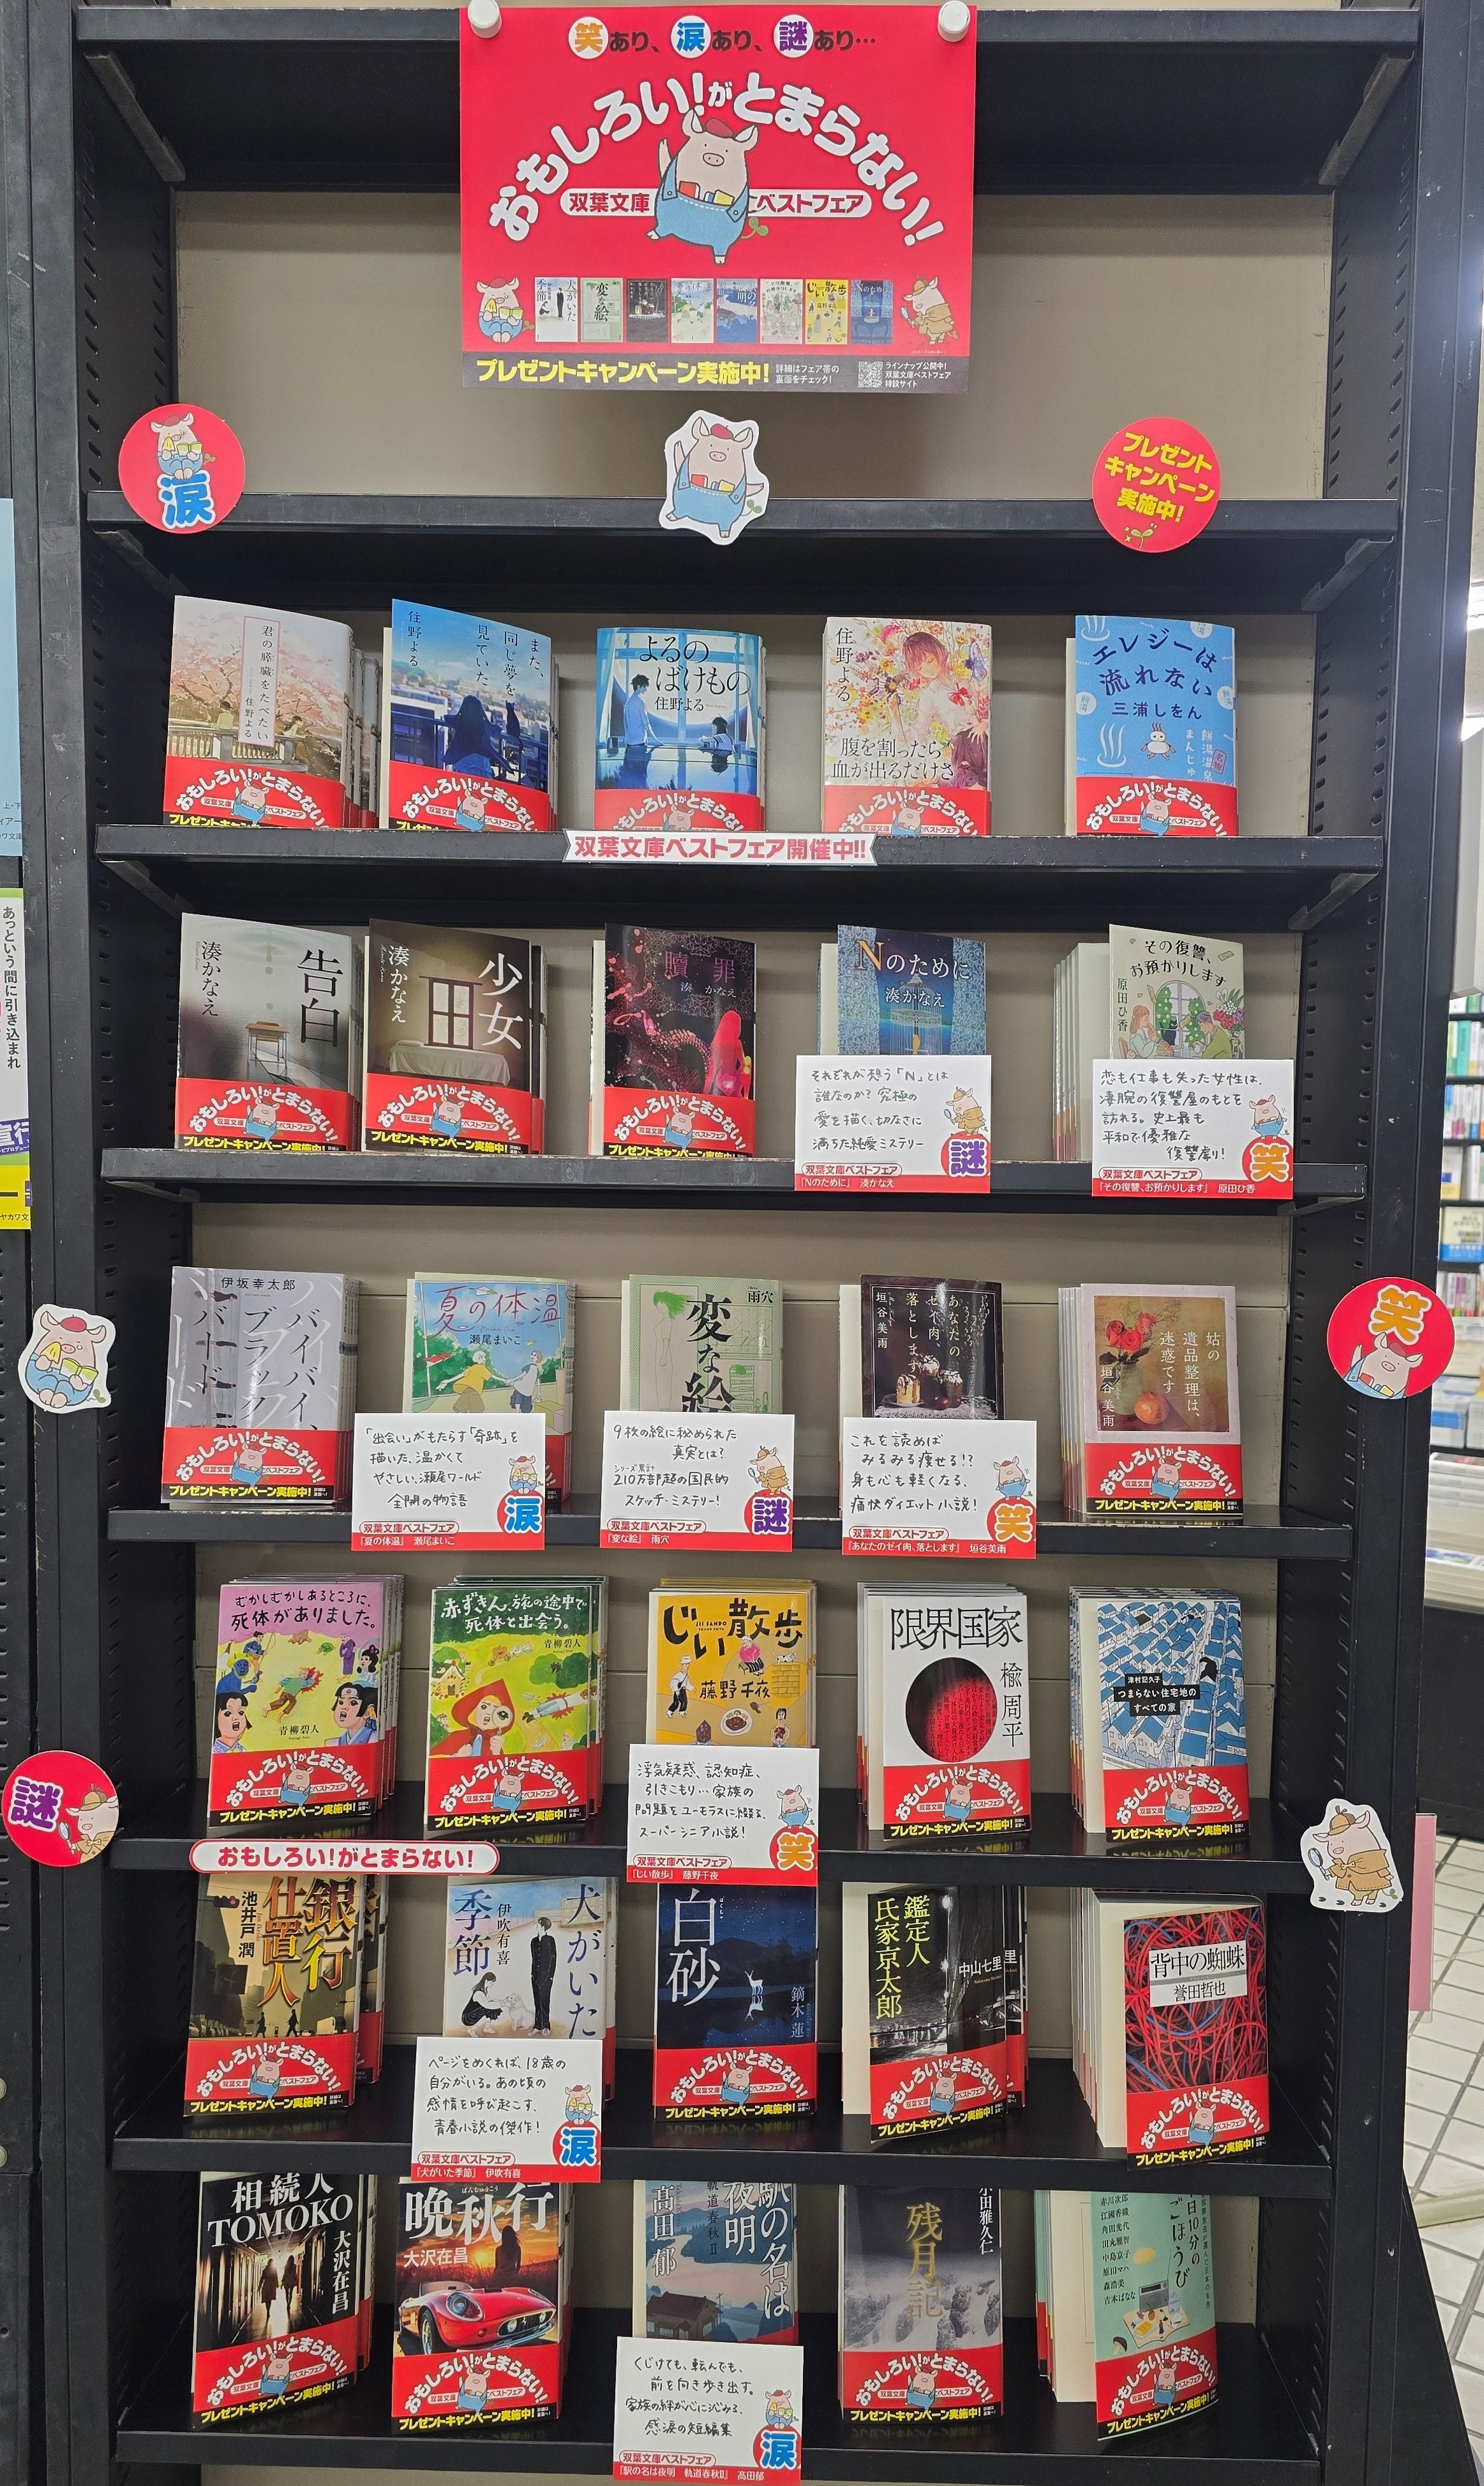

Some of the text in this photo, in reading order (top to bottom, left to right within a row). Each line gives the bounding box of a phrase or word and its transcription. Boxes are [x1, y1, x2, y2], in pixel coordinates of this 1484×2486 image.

[489, 71, 944, 246] おもしろい!がとまらない!
[569, 192, 865, 214] 双葉文庫 ベストフェア
[594, 283, 609, 321] 変な絵
[478, 359, 769, 386] プレゼントキャンペーン実施中!
[776, 365, 839, 373] 詳細はフェア帯の
[1123, 432, 1212, 473] プレゼント
[1104, 456, 1215, 502] キャンペーン
[1117, 487, 1184, 522] 実施中!
[408, 611, 422, 667] 住野よる
[476, 625, 490, 686] 見ていた
[639, 636, 709, 664] よるの
[1093, 628, 1217, 673] エレジーは
[504, 631, 518, 696] 同じ夢を
[529, 639, 544, 677] また、
[835, 627, 854, 702] 住野よる
[257, 625, 275, 740] 君の膵臓をたべたい
[655, 666, 752, 695] ばけもの
[1099, 664, 1212, 696] 流れない
[244, 697, 254, 738] 住野よる
[655, 697, 704, 711] 住野よる
[1112, 701, 1202, 720] 三浦しをん
[841, 738, 941, 758] 腹を割ったら
[831, 761, 954, 781] 血が出るだけさ
[574, 836, 866, 860] 双葉文庫ベストフェア開催中!!
[857, 940, 971, 981] Nのために
[1144, 939, 1212, 964] その復讐、
[202, 940, 222, 1017] 湊かなえ
[388, 945, 410, 1023] 湊かなえ
[1130, 959, 1226, 987] お預かりします
[297, 949, 343, 1047] 告白
[478, 953, 524, 1049] 少女
[885, 987, 946, 1009] 湊かなえ
[1117, 977, 1128, 1033] 原田ひ香
[189, 1085, 338, 1142] おもしろい!がとまらない!
[1102, 1130, 1190, 1144] 平和で優雅な
[805, 1165, 898, 1176] 双葉文庫ベストフェア
[1252, 1144, 1287, 1182] 笑
[859, 1178, 894, 1189] 湊かなえ
[1099, 1182, 1256, 1194] 『その復讐、お預かりします』 原田ひ香
[221, 1276, 296, 1291] 伊坂幸太郎
[747, 1289, 774, 1304] 雨穴
[422, 1285, 562, 1341] 夏の体温
[876, 1292, 889, 1350] 垣谷美雨
[948, 1294, 960, 1358] あなたの
[1370, 1287, 1430, 1343] 笑
[469, 1334, 522, 1345] 瀬尾まいこ
[906, 1292, 919, 1372] 落とします
[1205, 1332, 1221, 1362] 姑の
[681, 1293, 737, 1413] 変な絵
[1160, 1331, 1176, 1395] 迷惑です
[1182, 1331, 1200, 1420] 遺品整理は、
[1100, 1367, 1115, 1427] 垣谷美雨
[176, 1431, 326, 1483] おもしろい!がとまらない!
[851, 1433, 944, 1448] これを読めば
[169, 1485, 312, 1498] プレゼントキャンペーン実施中!
[387, 1492, 468, 1509] 全開の物語
[611, 1521, 702, 1532] 双葉文庫ベストフェア
[753, 1498, 788, 1533] 謎
[413, 1535, 455, 1546] 瀬尾まいこ
[651, 1533, 670, 1545] 雨穴
[852, 1528, 945, 1540] 双葉文庫ベストフェア
[969, 1543, 1006, 1554] 垣谷美雨
[235, 1589, 371, 1609] むかしむかしあるところに、
[441, 1591, 588, 1619] 赤ずきん、旅の途中で
[230, 1607, 377, 1631] 死体がありました。
[465, 1614, 569, 1634] 死体と出会う。
[663, 1597, 803, 1660] じい散歩
[891, 1605, 1024, 1651] 限界国家
[544, 1639, 581, 1649] 青柳碧人
[699, 1679, 771, 1700] 藤野千夜
[1118, 1687, 1196, 1698] つまらない住宅地の
[1128, 1676, 1161, 1684] 津村記久子
[1000, 1662, 1024, 1748] 楡周平
[1134, 1703, 1176, 1713] すべての家
[278, 1725, 320, 1736] 青柳碧人
[10, 1778, 62, 1831] 謎
[219, 1803, 356, 1823] プレゼントキャンペーン実施中!
[218, 1847, 474, 1868] おもしろい!がとまらない!
[682, 1869, 719, 1881] 藤野千夜
[239, 1891, 258, 1959] 池井戸潤
[256, 1876, 306, 2008] 仕置人
[301, 1876, 358, 1991] 銀行
[452, 1889, 493, 1976] 季節
[496, 1903, 511, 1966] 伊吹有喜
[903, 1895, 931, 1967] 鑑定人
[567, 1883, 602, 2040] 犬がいた
[666, 1887, 721, 2007] 白砂
[874, 1897, 903, 2020] 氏家京太郎
[1151, 1944, 1245, 1979] 背中の蜘蛛
[959, 1955, 1002, 1978] 中山七里
[1174, 1983, 1226, 2002] 誉田哲也
[670, 2050, 808, 2104] おもしろい!がとまらない!
[560, 2128, 596, 2165] 涙
[485, 2167, 522, 2179] 伊吹有喜
[231, 2173, 334, 2213] 相続人
[1100, 2194, 1129, 2207] 赤川次郎
[207, 2193, 354, 2248] TOMOKO
[405, 2182, 554, 2245] 晩秋行
[723, 2182, 757, 2256] 夜明
[1102, 2221, 1130, 2235] 角田光代
[403, 2247, 468, 2268] 大沢在昌
[1102, 2249, 1131, 2263] 中島京子
[1169, 2196, 1190, 2289] ごほうび
[332, 2230, 352, 2315] 大沢在昌
[906, 2202, 945, 2320] 残月記
[1102, 2265, 1130, 2277] 原田マハ
[1104, 2291, 1136, 2306] 吉本ばなな
[644, 2419, 733, 2437] 感涙の短編集
[623, 2453, 712, 2465] 双葉文庫ベストフェア
